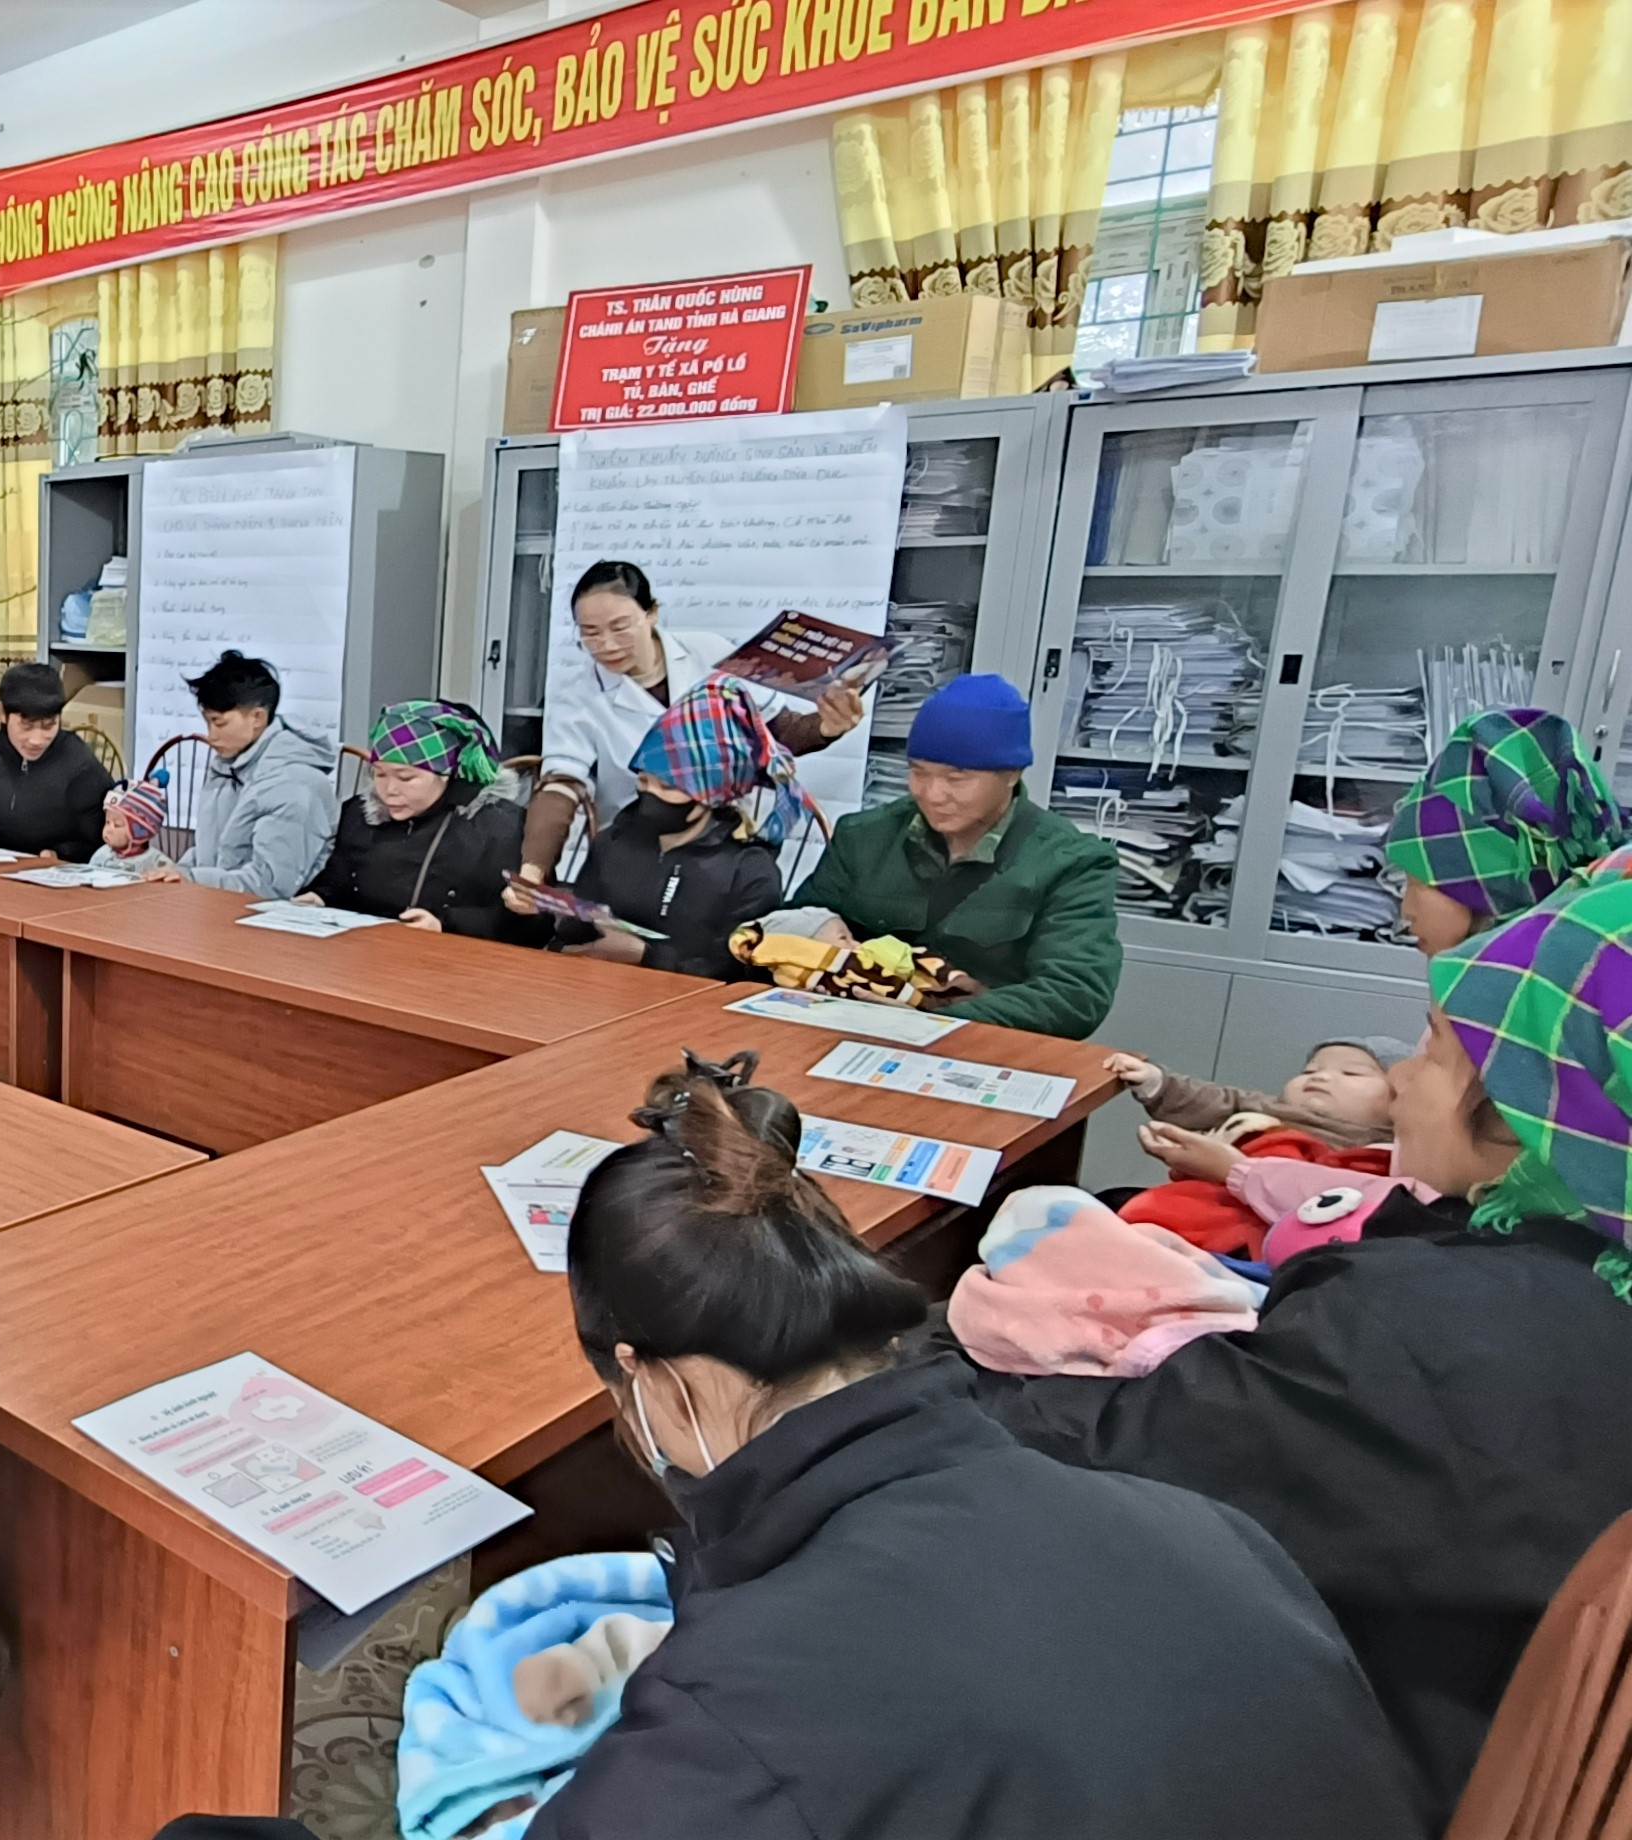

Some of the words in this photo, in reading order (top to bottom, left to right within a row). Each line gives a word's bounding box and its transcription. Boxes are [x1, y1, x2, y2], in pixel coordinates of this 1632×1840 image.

[47, 174, 118, 254] NGỪNG
[122, 158, 184, 235] NÂNG
[189, 146, 235, 219] CAO
[241, 132, 310, 204] CÔNG
[318, 103, 367, 188] TÁC
[375, 78, 463, 175] CHĂM
[469, 56, 542, 152] SÓC,
[552, 23, 626, 132] BẢO
[635, 17, 684, 125] VỆ
[688, 0, 771, 99] SỨC
[607, 300, 628, 317] TS.
[633, 294, 672, 314] THÂN
[675, 287, 716, 311] QUỐC
[719, 285, 764, 305] HÙNG
[579, 321, 623, 340] CHÁNH
[625, 318, 645, 336] ÁN
[648, 317, 683, 333] TAND
[686, 310, 718, 329] TỈNH
[720, 308, 739, 326] HÀ
[742, 305, 787, 323] GIANG
[643, 335, 709, 358] Tặng
[601, 366, 642, 384] TRẠM
[645, 364, 656, 379] Y
[658, 358, 677, 378] TẾ
[623, 381, 644, 401] TỦ,
[648, 382, 683, 398] BÀN,
[687, 376, 719, 395] GHẾ
[580, 407, 602, 424] TRỊ
[605, 404, 633, 420] GIÁ:
[637, 400, 716, 418] 22.000.000
[720, 396, 758, 412] đồng
